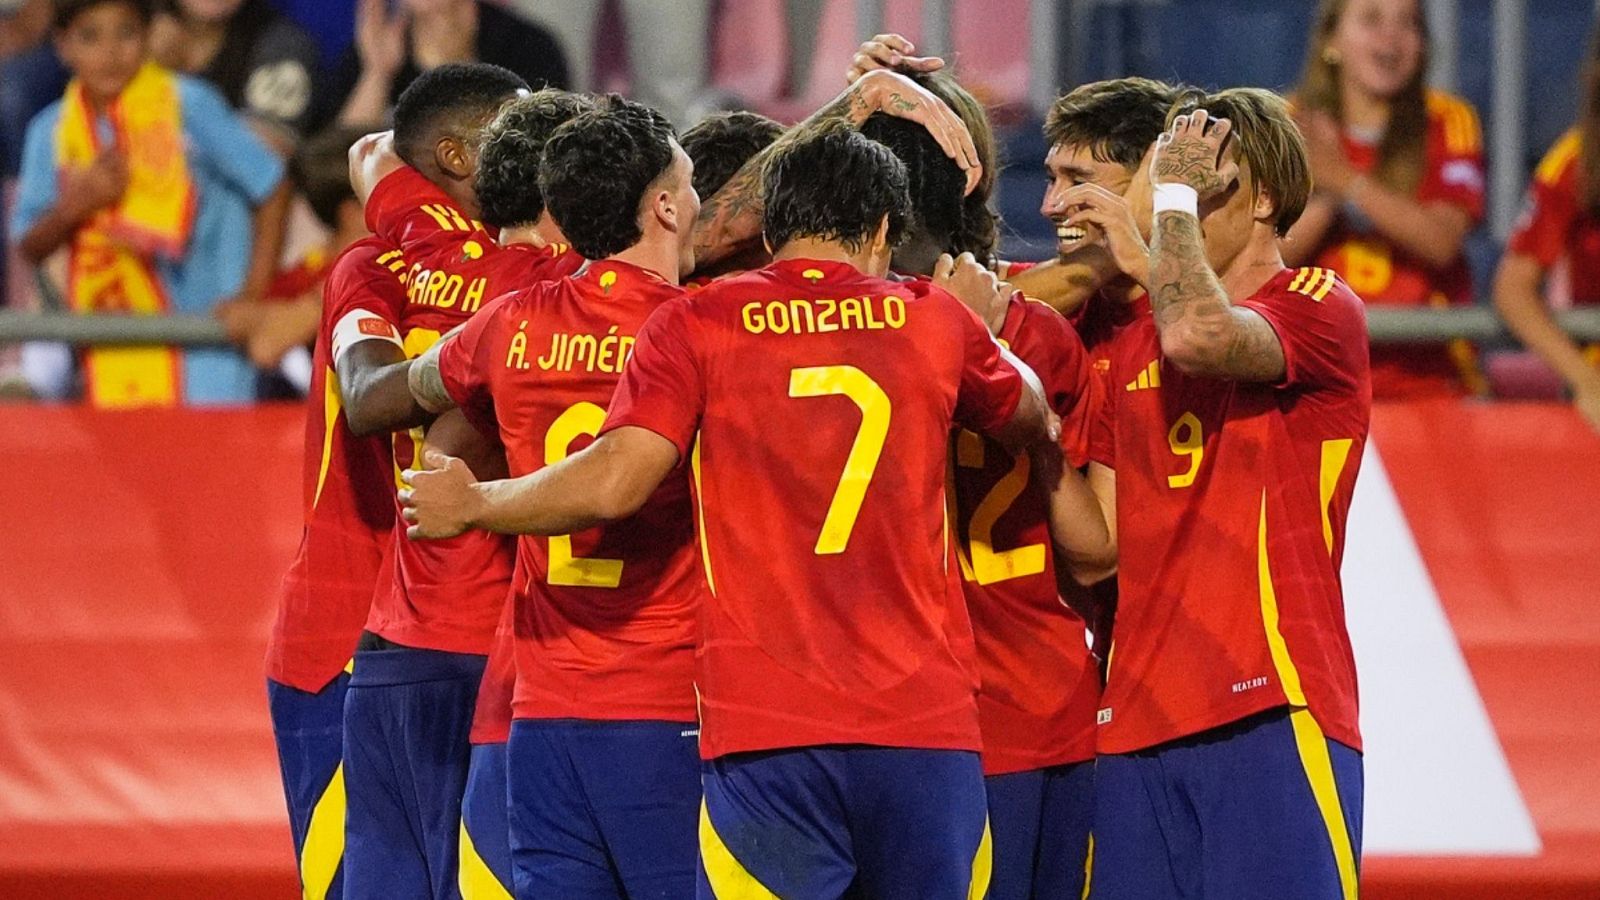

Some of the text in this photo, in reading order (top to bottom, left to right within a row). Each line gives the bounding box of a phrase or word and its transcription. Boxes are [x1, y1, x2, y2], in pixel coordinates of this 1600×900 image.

[506, 320, 530, 369] Á.
[742, 296, 906, 334] GONZALO
[788, 365, 892, 555] 7
[1168, 411, 1204, 488] 9
